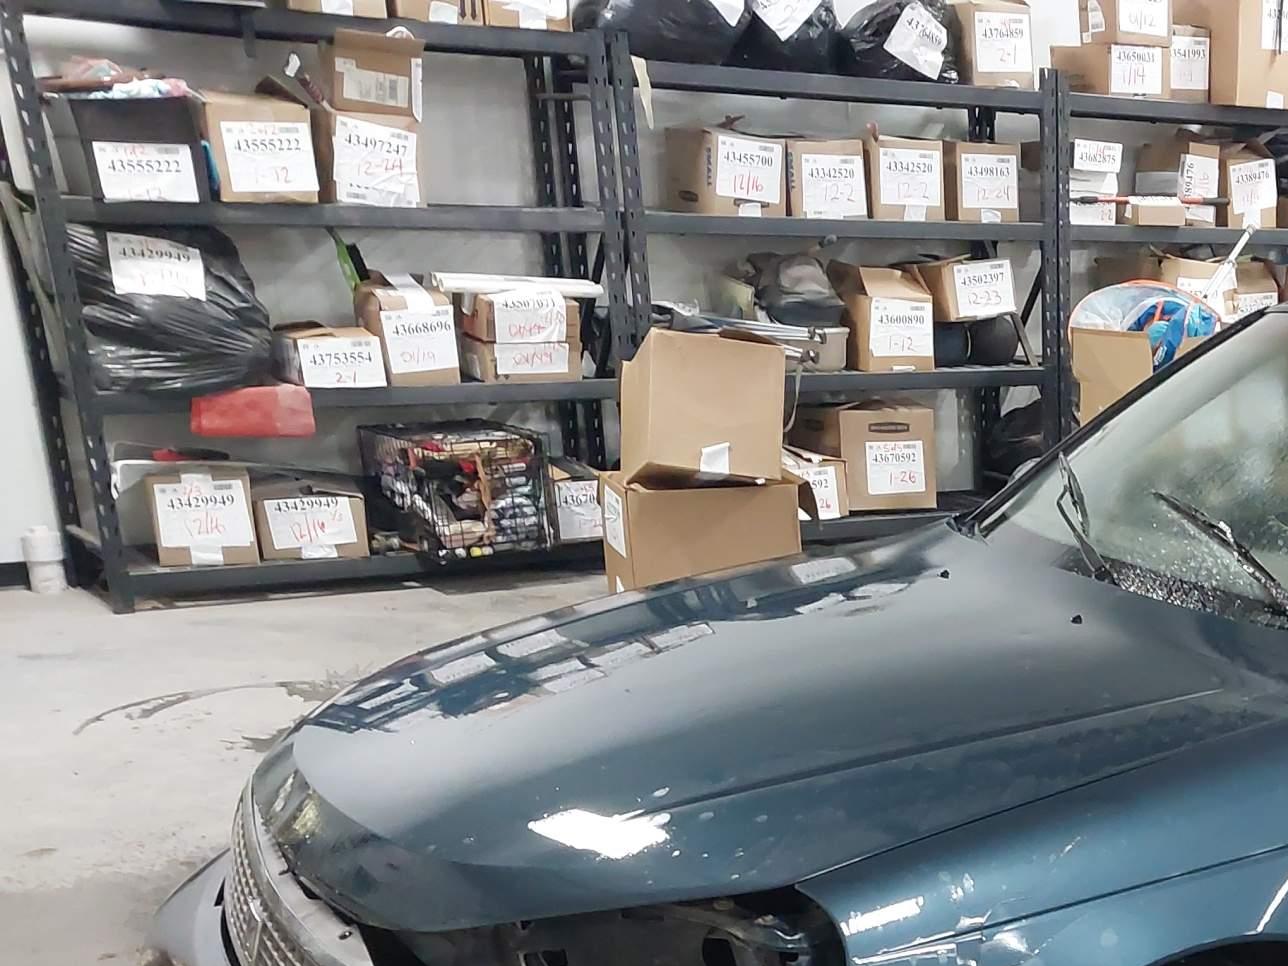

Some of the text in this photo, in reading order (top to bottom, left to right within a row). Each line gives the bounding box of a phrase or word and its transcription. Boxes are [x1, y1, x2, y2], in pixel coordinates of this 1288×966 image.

[234, 138, 302, 153] 43555222
[345, 133, 408, 156] 43497247
[107, 159, 182, 174] 43555222
[723, 151, 774, 168] 43455700
[807, 167, 856, 180] 43342520
[885, 161, 934, 174] 43342520
[967, 166, 1011, 178] 43498163
[961, 272, 1005, 287] 43502397
[878, 315, 925, 326] 43600890
[393, 320, 451, 337] 43668696
[310, 351, 372, 366] 43753554
[872, 453, 917, 464] 43670592
[167, 494, 235, 511] 43429949
[274, 497, 339, 513] 43429949
